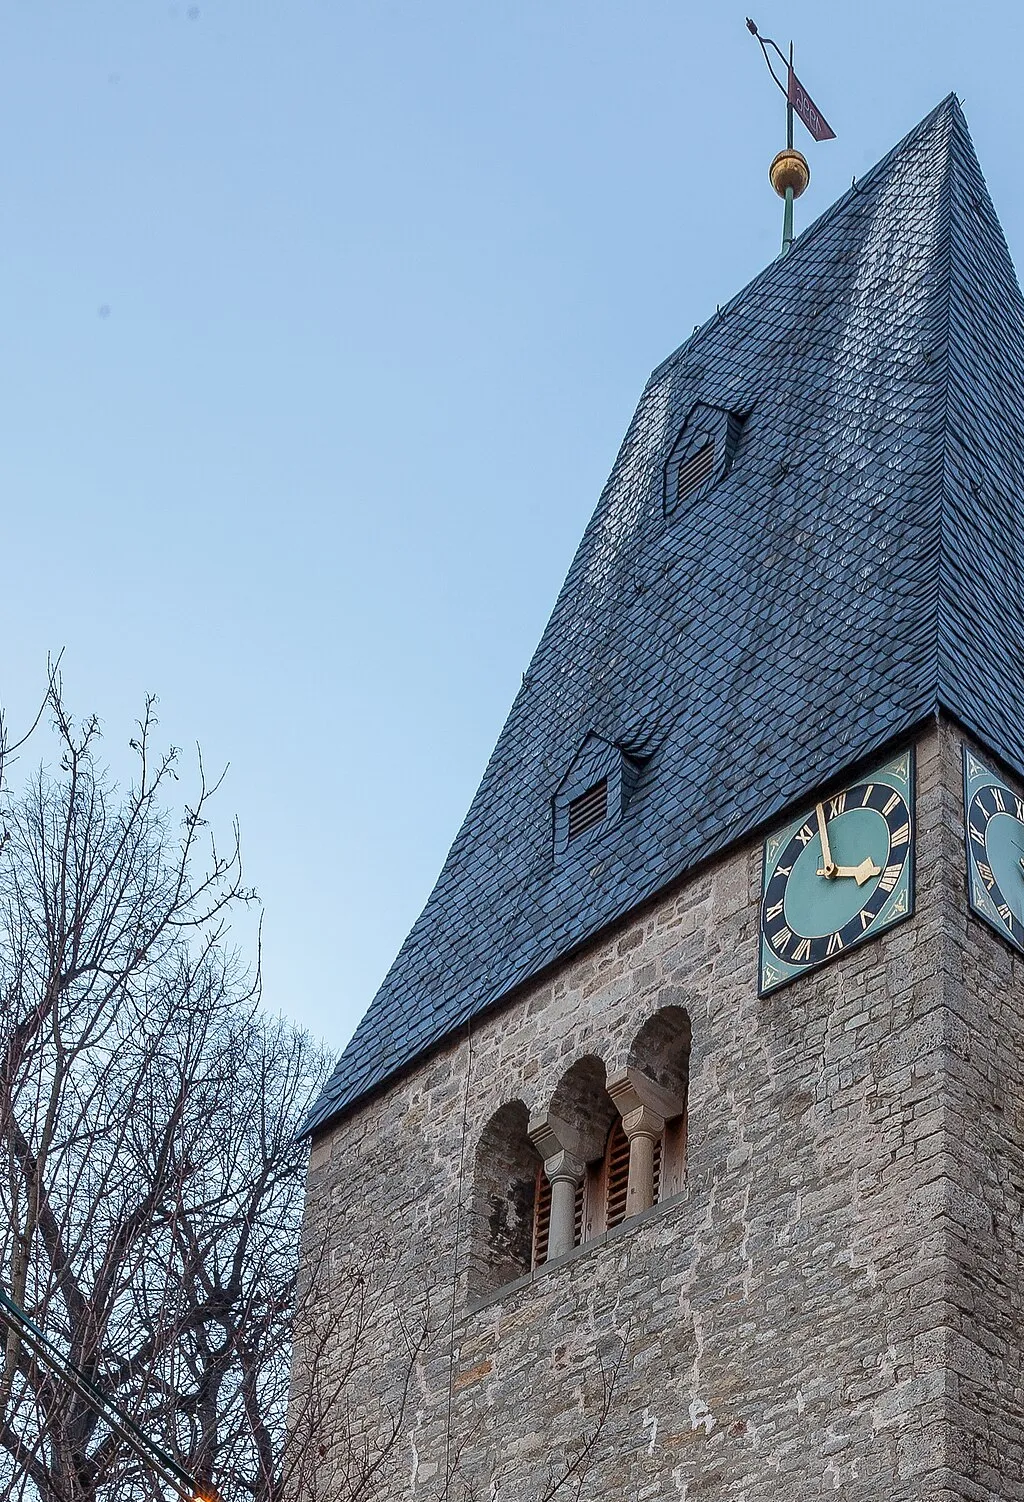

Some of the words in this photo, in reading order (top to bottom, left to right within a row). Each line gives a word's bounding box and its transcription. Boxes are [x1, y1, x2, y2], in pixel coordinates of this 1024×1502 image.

[830, 793, 847, 820] XII
[862, 785, 873, 806] I
[882, 792, 900, 816] II
[975, 795, 990, 820] X
[990, 788, 1006, 811] XI
[795, 824, 814, 846] XI
[891, 822, 909, 848] III
[969, 821, 986, 847] IX
[774, 865, 792, 878] X
[878, 863, 903, 893] IIII
[977, 860, 995, 891] VIII
[766, 898, 783, 922] IX
[860, 909, 875, 929] V
[997, 903, 1013, 931] VII
[771, 926, 792, 954] VIII
[791, 939, 811, 961] VII
[826, 932, 844, 955] VI
